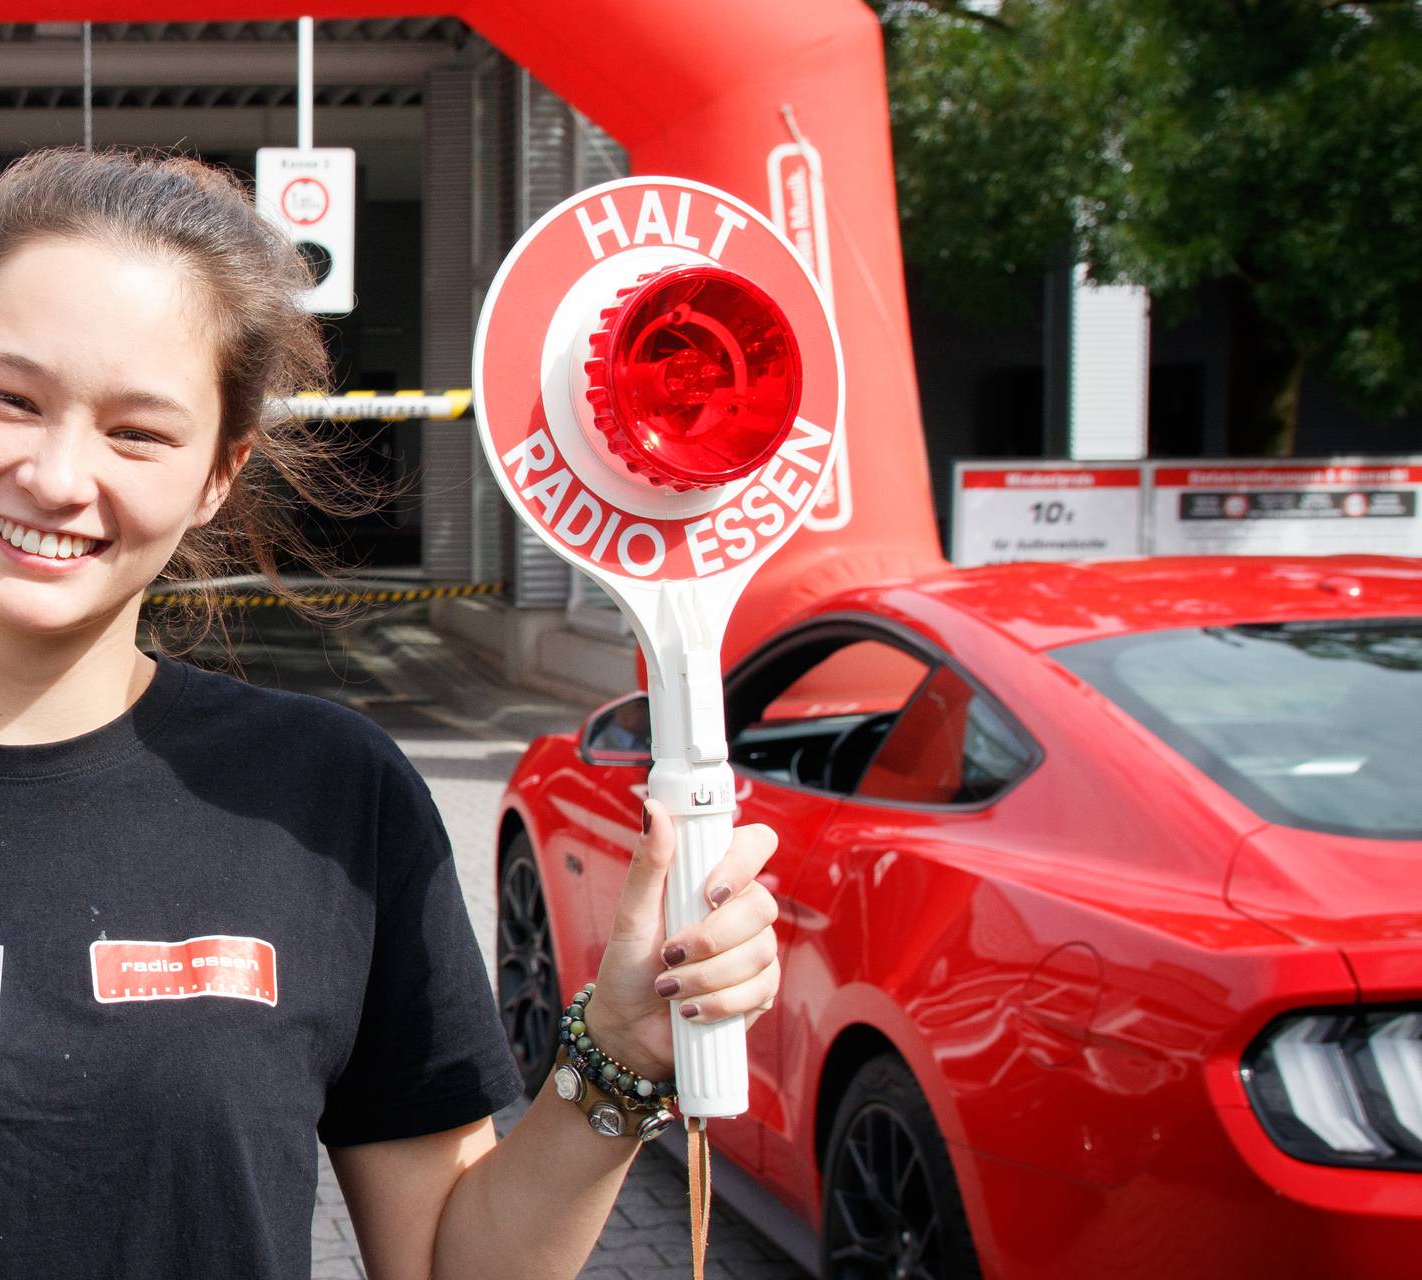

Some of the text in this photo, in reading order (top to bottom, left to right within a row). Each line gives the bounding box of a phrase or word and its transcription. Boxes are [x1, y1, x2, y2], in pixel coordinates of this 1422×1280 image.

[575, 190, 748, 261] HALT
[502, 416, 832, 577] RADIO ESSEN
[122, 956, 259, 973] radio essen
